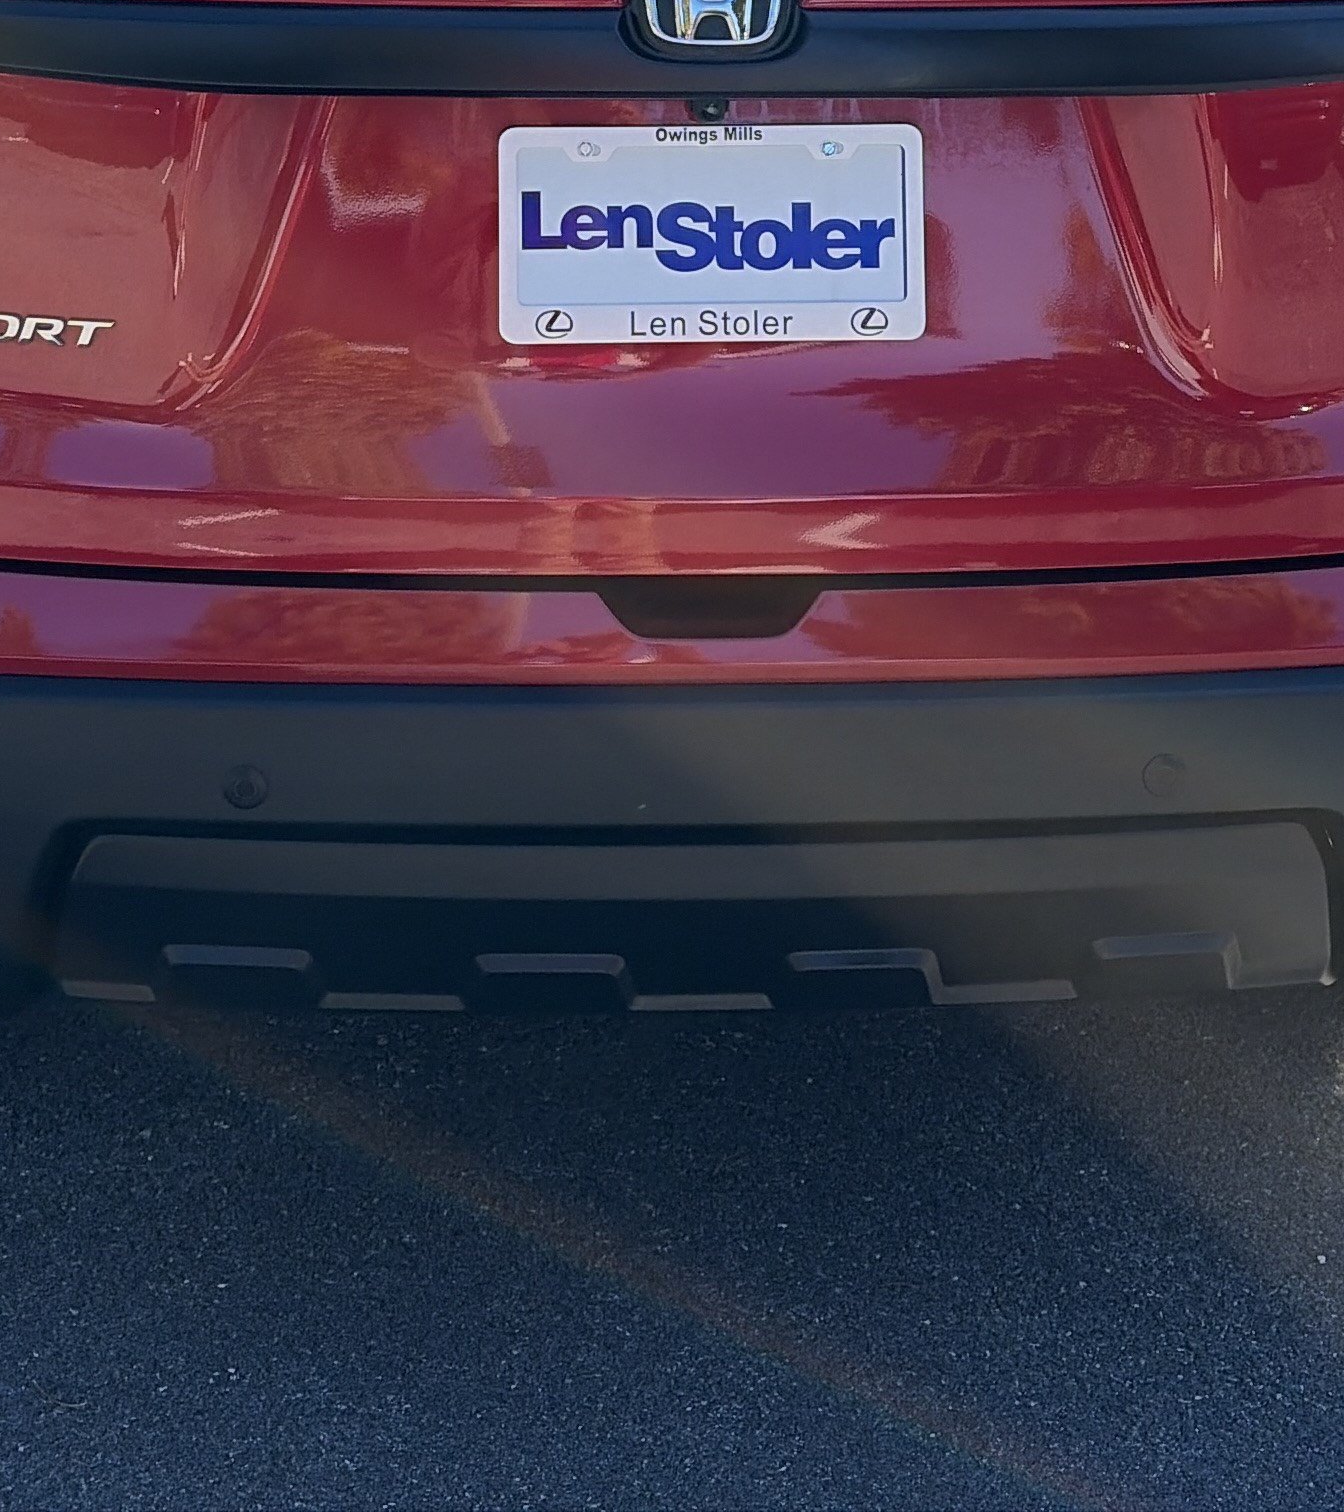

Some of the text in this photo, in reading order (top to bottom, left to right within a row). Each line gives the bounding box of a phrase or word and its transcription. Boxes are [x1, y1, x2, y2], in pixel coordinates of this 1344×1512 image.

[655, 126, 763, 145] Owings Mills
[629, 309, 793, 337] Len Stoler
